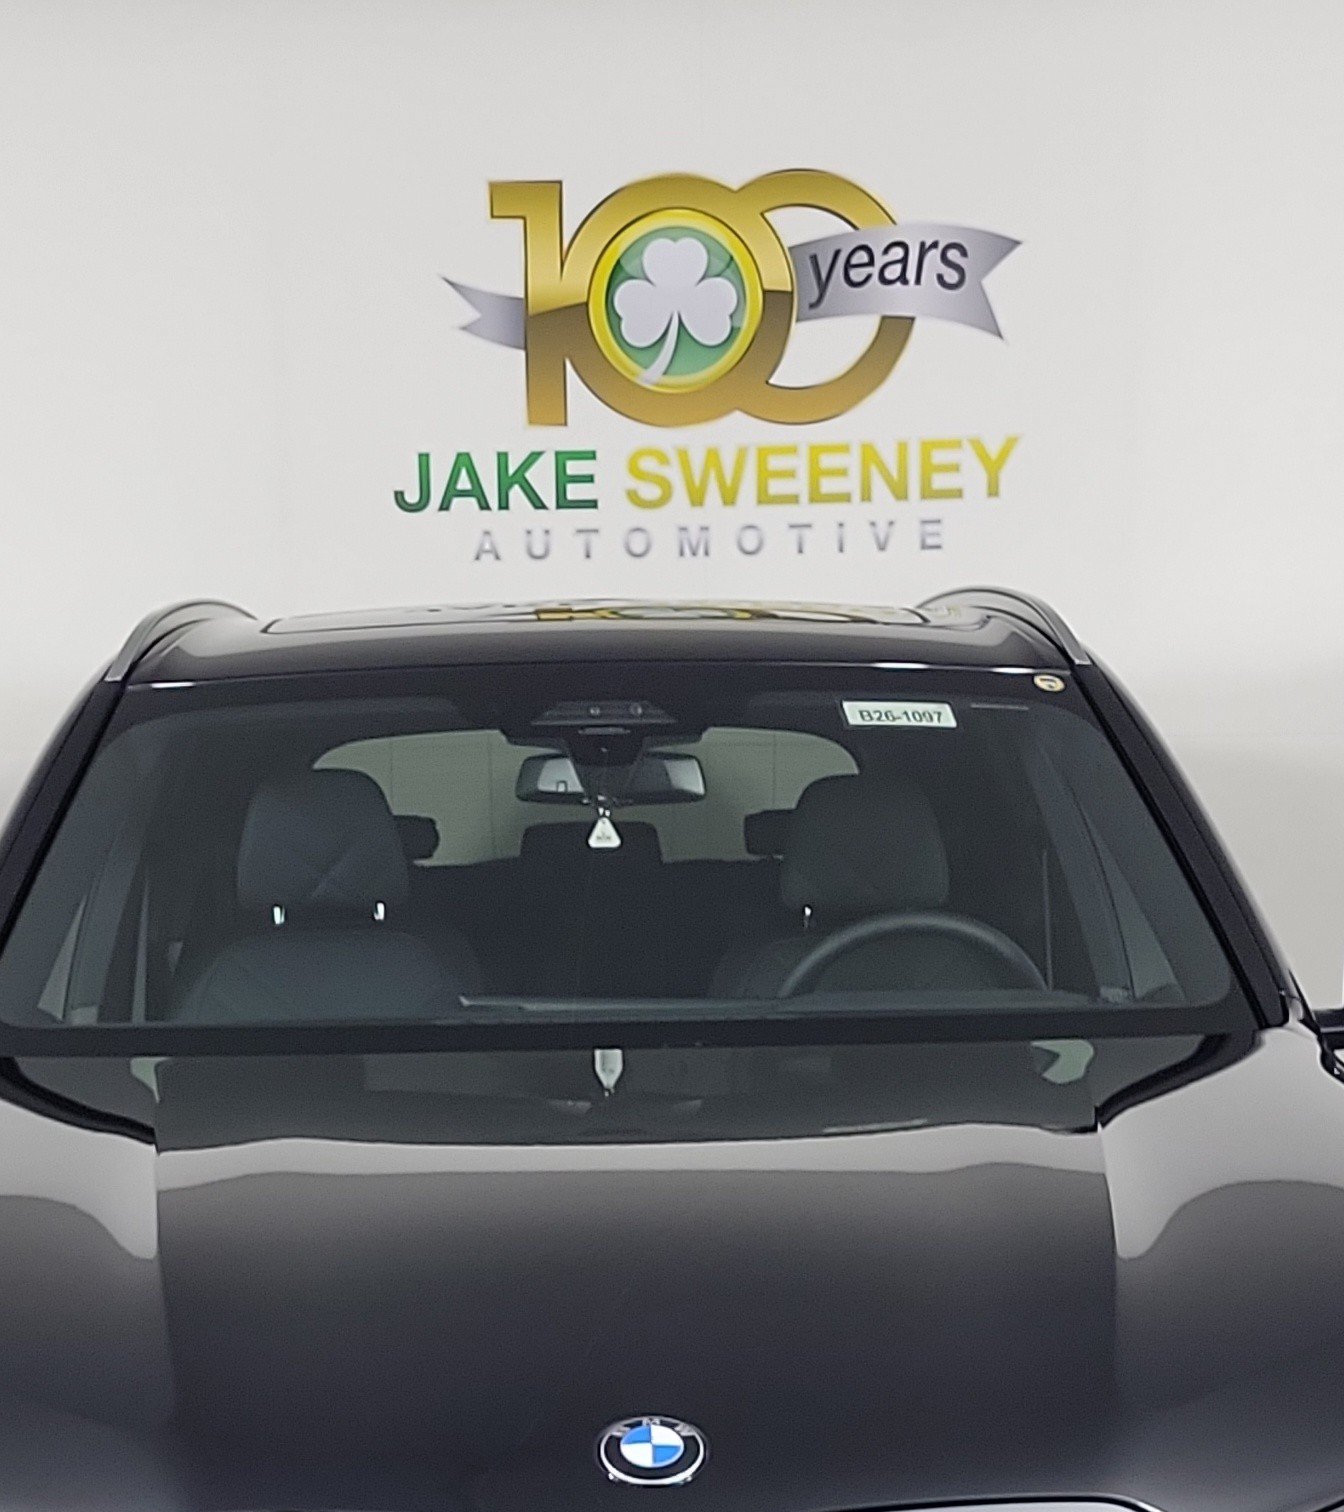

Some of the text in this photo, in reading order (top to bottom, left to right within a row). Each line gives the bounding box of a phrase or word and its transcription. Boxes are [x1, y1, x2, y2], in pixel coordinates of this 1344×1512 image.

[488, 168, 968, 426] 100 years
[394, 435, 1021, 514] JAKE SWEENEY
[474, 519, 944, 563] AUTOMOTIVE
[859, 709, 943, 724] B26-1097
